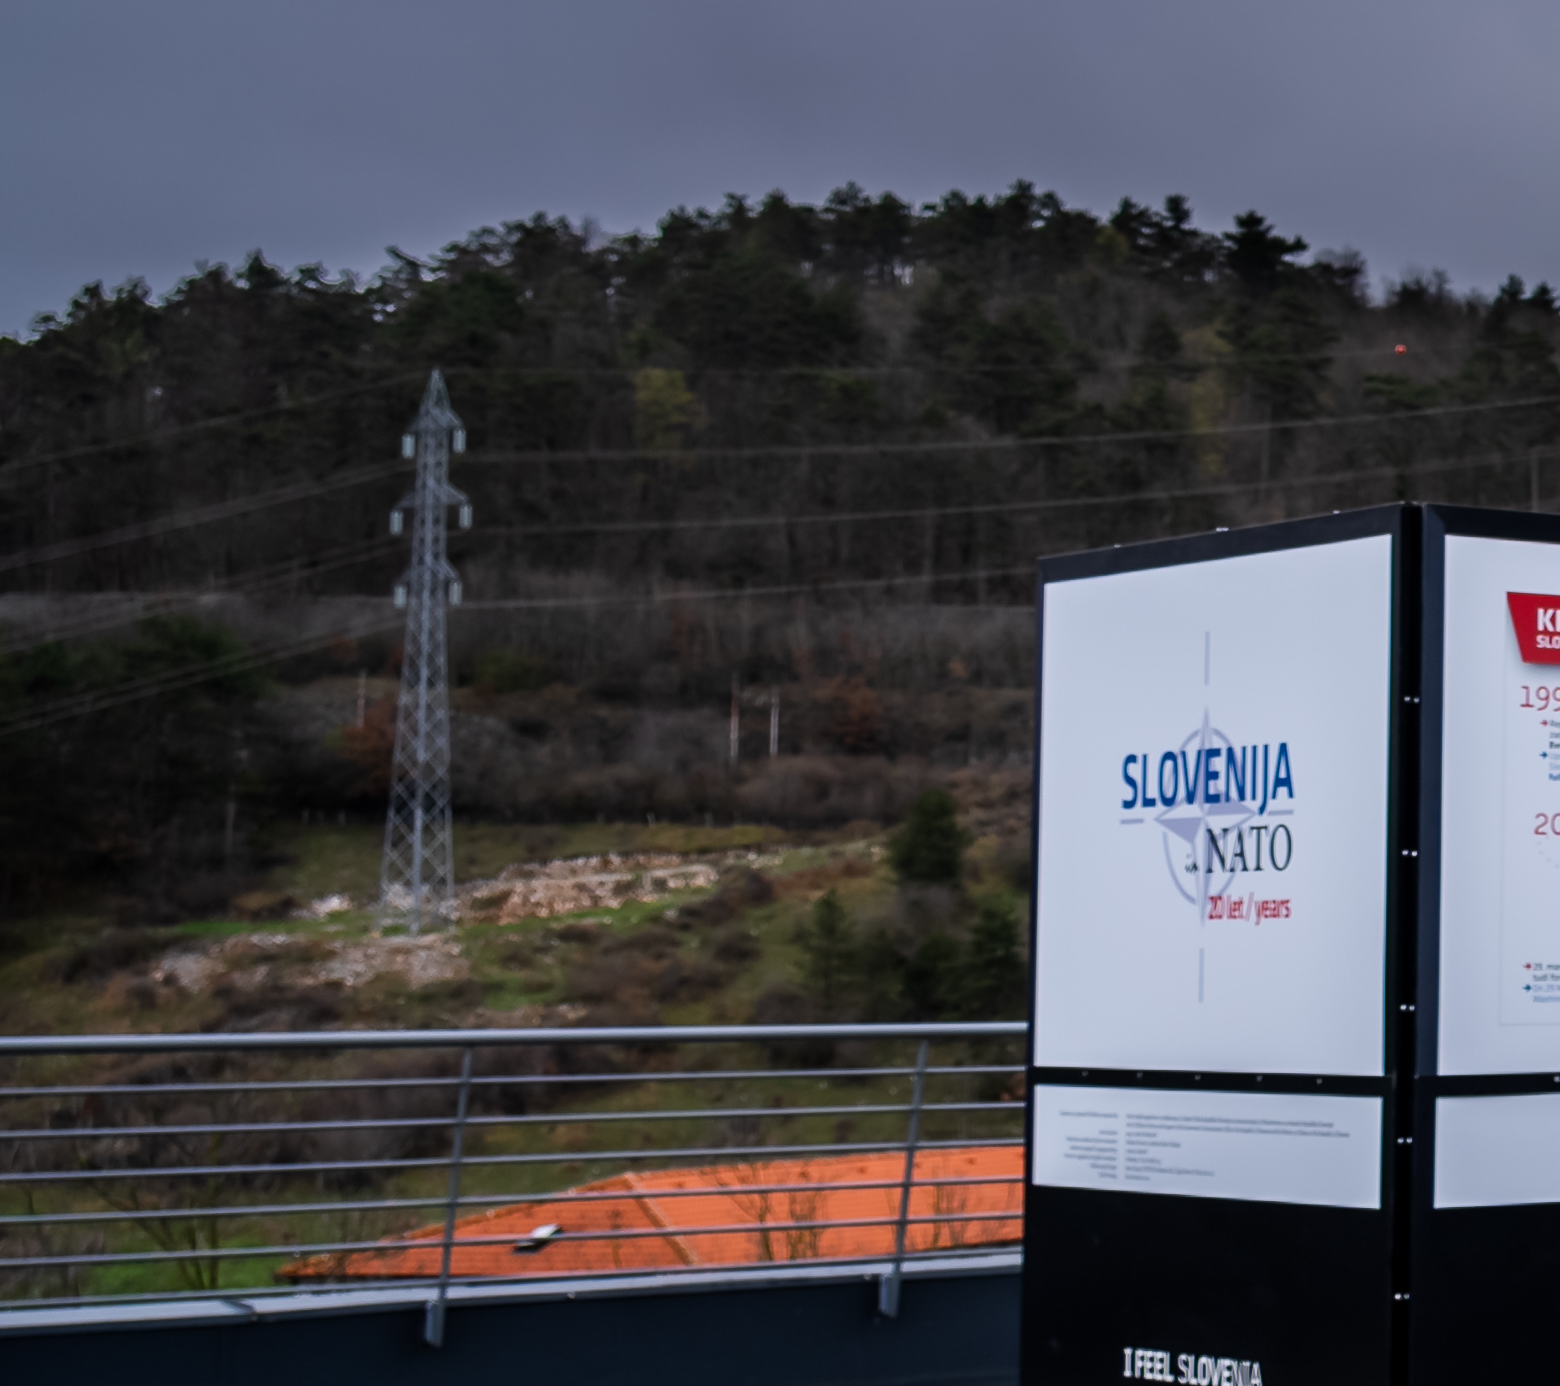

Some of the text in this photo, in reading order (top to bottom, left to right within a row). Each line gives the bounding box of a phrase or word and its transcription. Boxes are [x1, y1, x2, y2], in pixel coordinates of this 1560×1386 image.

[1122, 743, 1294, 815] SLOVENIJA
[1206, 824, 1293, 874] NATO
[1124, 1348, 1132, 1377] I
[1135, 1350, 1174, 1382] FEEL
